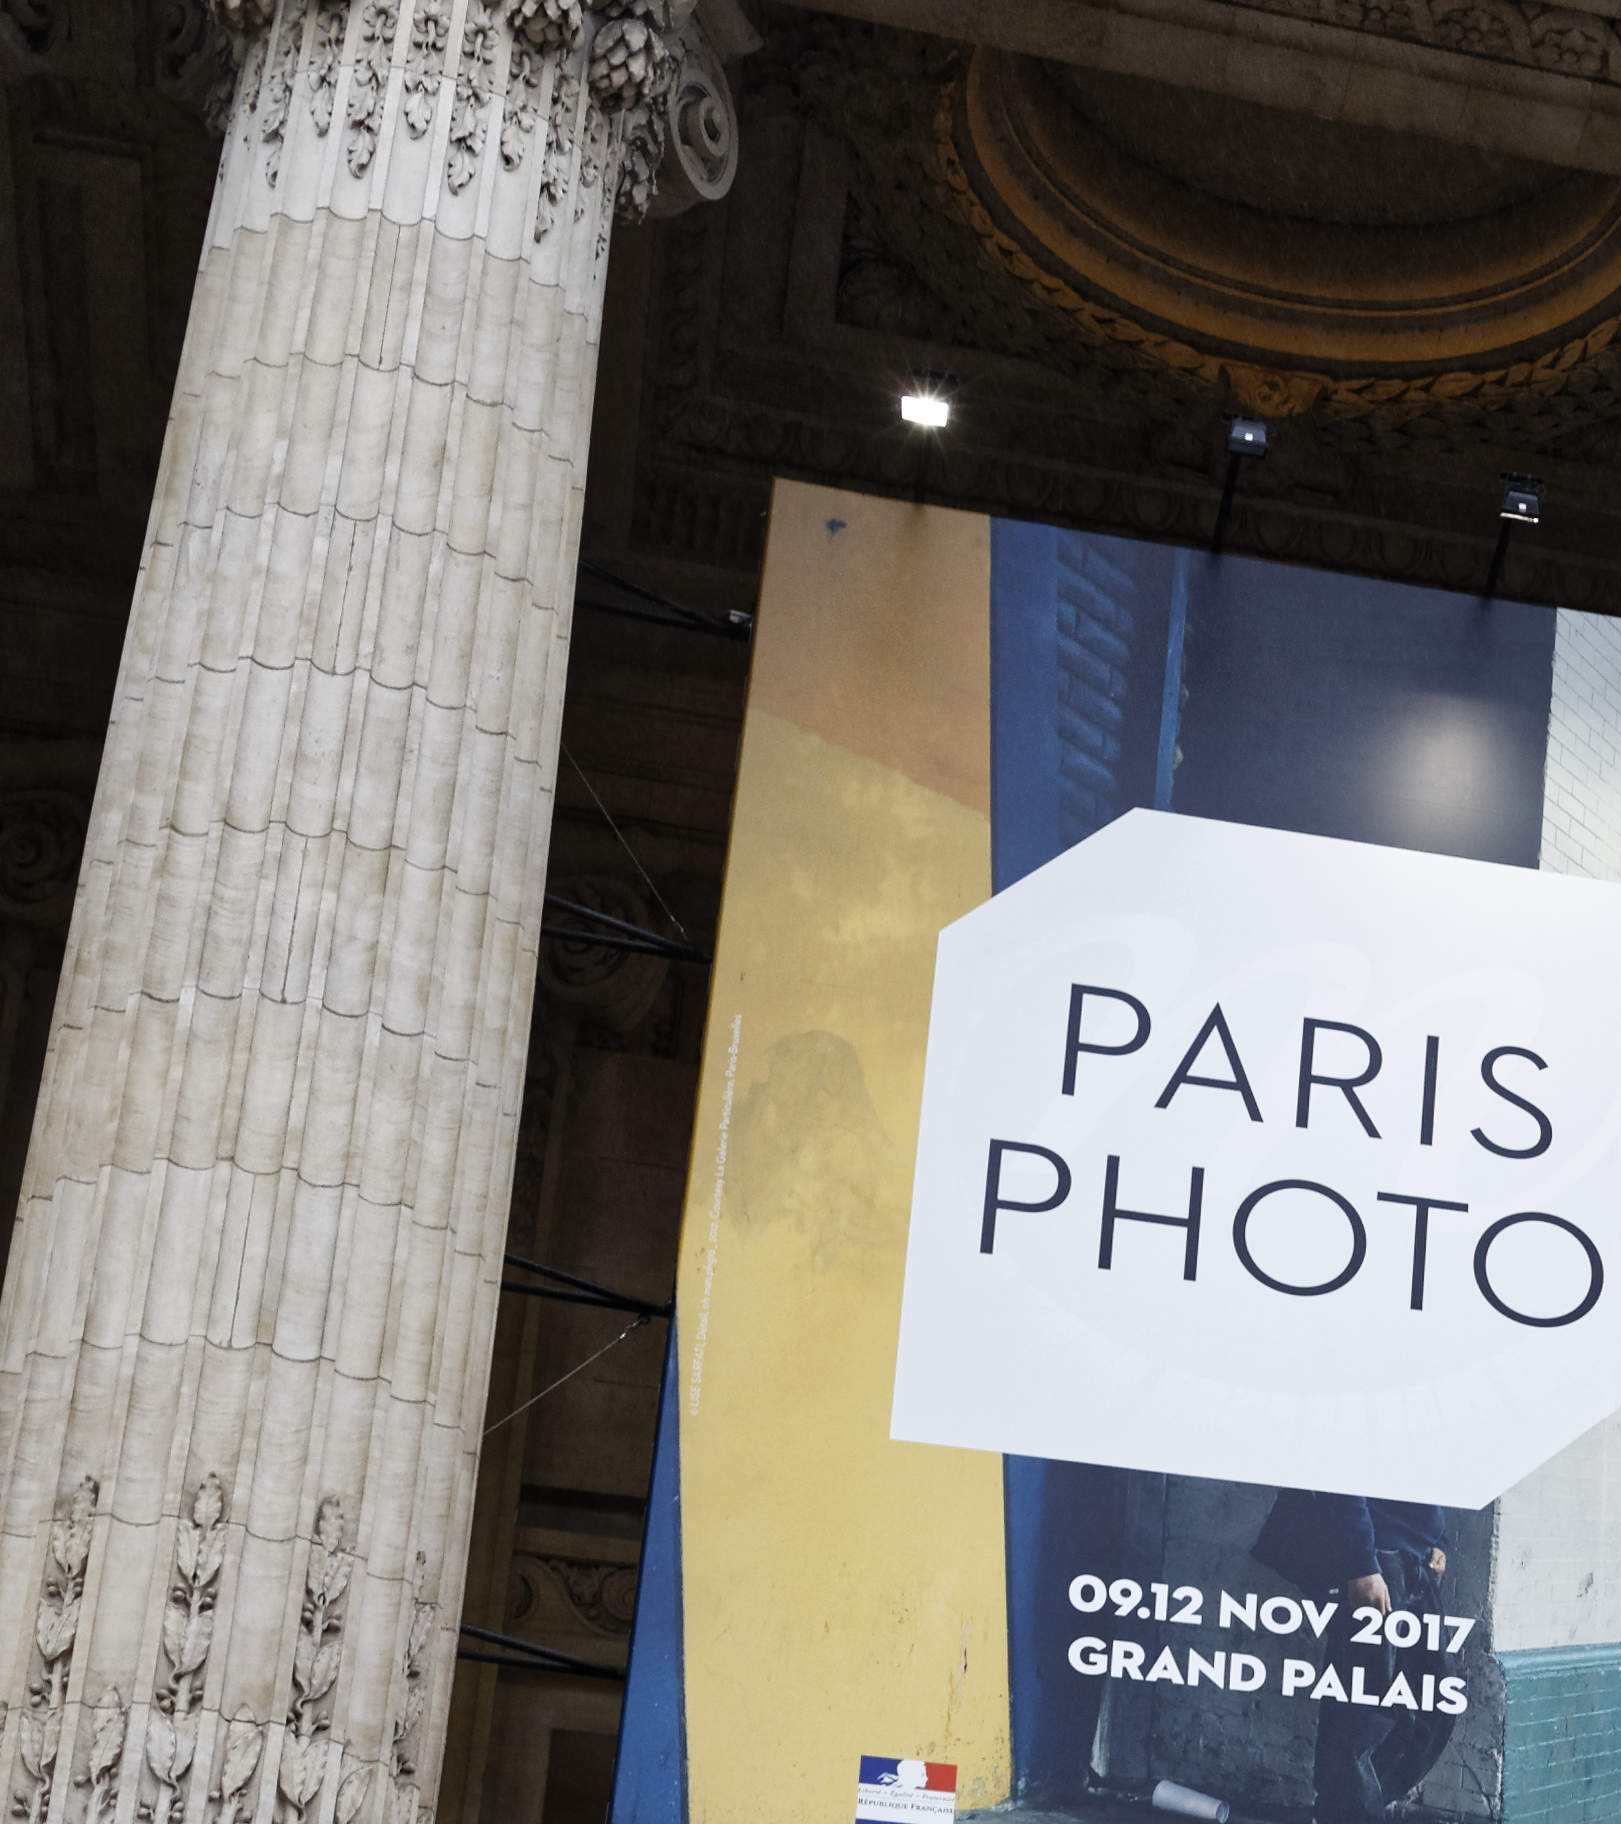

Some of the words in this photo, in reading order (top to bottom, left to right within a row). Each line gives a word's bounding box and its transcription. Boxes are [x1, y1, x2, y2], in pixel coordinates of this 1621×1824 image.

[1061, 983, 1553, 1160] PARIS
[979, 1138, 1604, 1328] PHOTO
[1068, 1574, 1203, 1625] 09.12
[1219, 1589, 1339, 1638] NOV
[1350, 1606, 1476, 1654] 2017
[1068, 1636, 1266, 1692] GRAND
[1281, 1658, 1468, 1715] PALAIS
